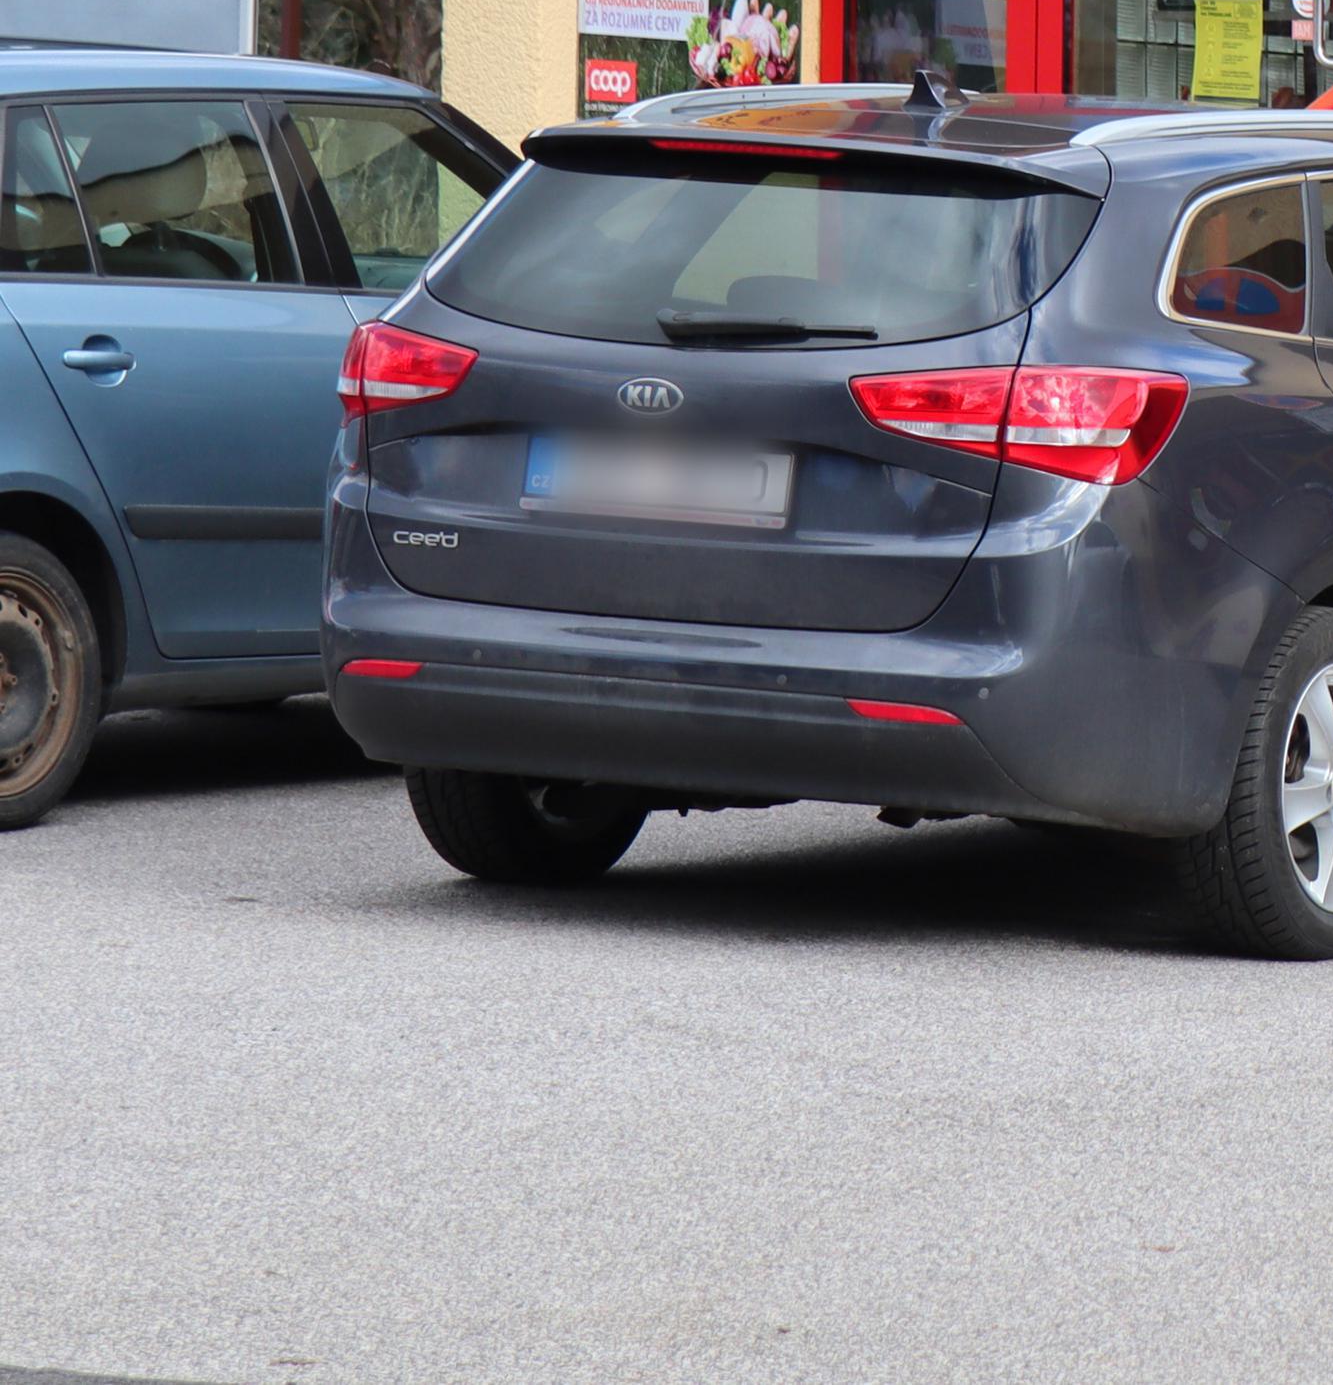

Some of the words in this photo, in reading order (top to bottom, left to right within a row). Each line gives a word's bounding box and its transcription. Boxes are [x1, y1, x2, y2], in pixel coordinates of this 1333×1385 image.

[585, 10, 599, 27] ZA
[601, 11, 653, 30] ROZUMNÉ
[655, 15, 682, 32] CENY
[590, 68, 631, 98] coop
[626, 387, 670, 409] KIA
[531, 474, 552, 488] CZ
